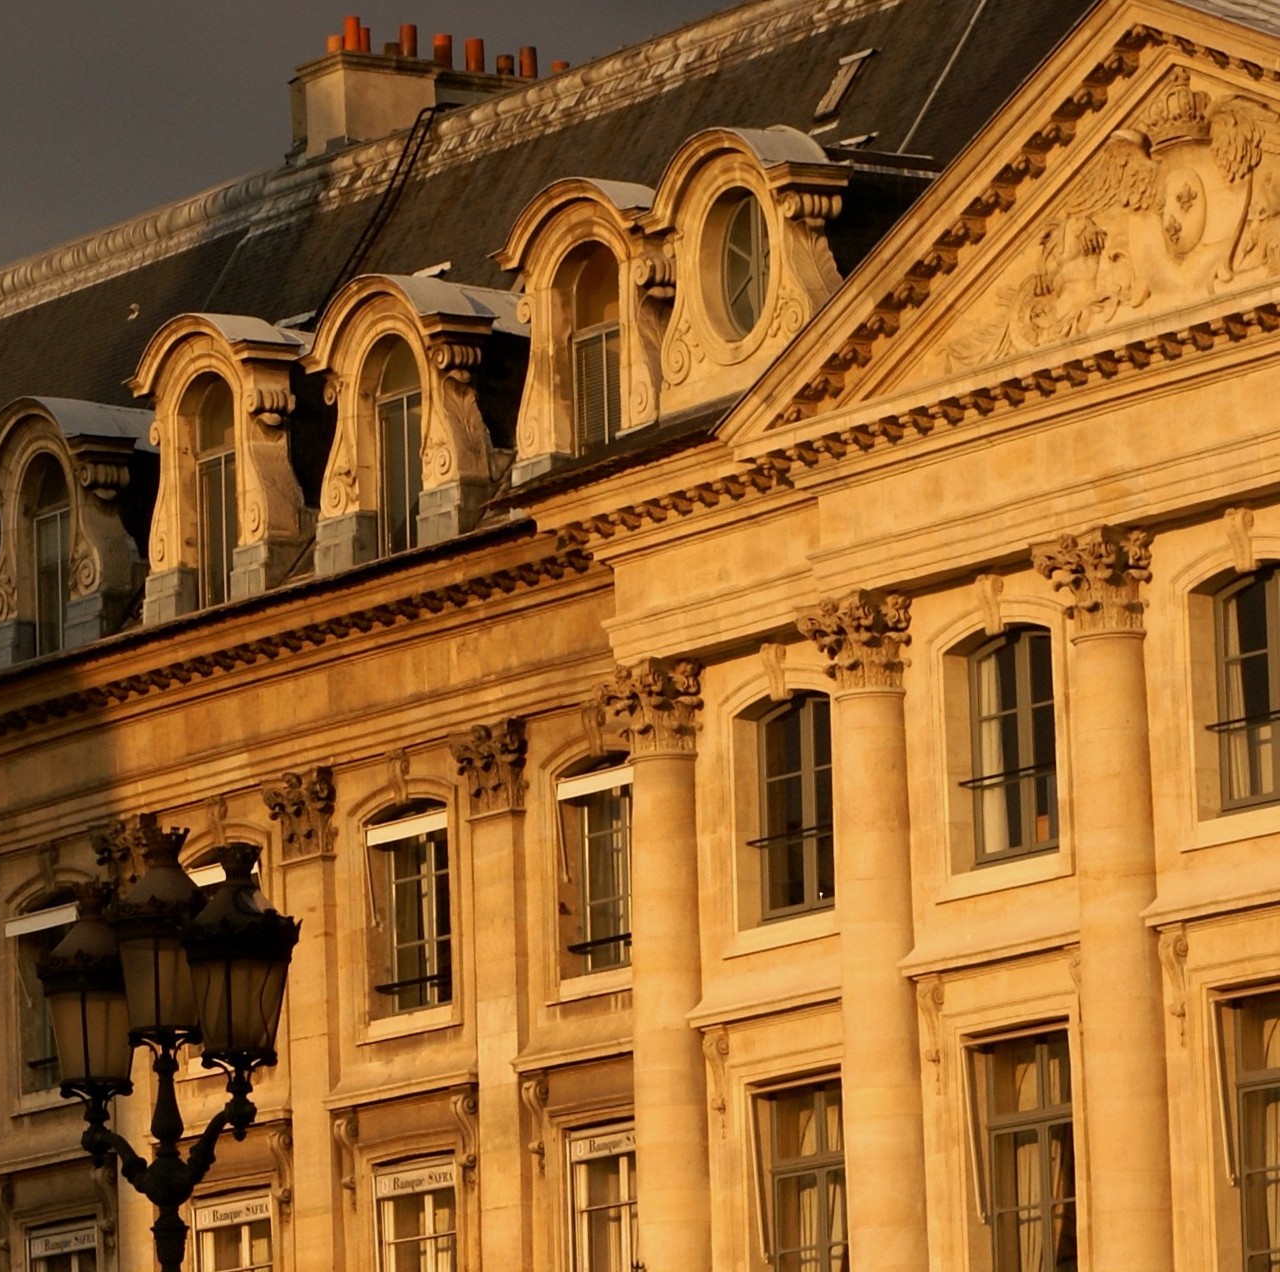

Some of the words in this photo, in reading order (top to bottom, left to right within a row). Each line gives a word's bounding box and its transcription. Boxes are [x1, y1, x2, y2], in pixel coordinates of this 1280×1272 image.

[588, 1138, 622, 1154] Banque
[392, 1176, 425, 1191] Banque
[427, 1170, 454, 1185] SAFRA
[212, 1208, 242, 1224] Banque
[244, 1203, 269, 1216] SAFRA
[44, 1237, 73, 1253] Banque
[74, 1232, 96, 1247] SAFRA
